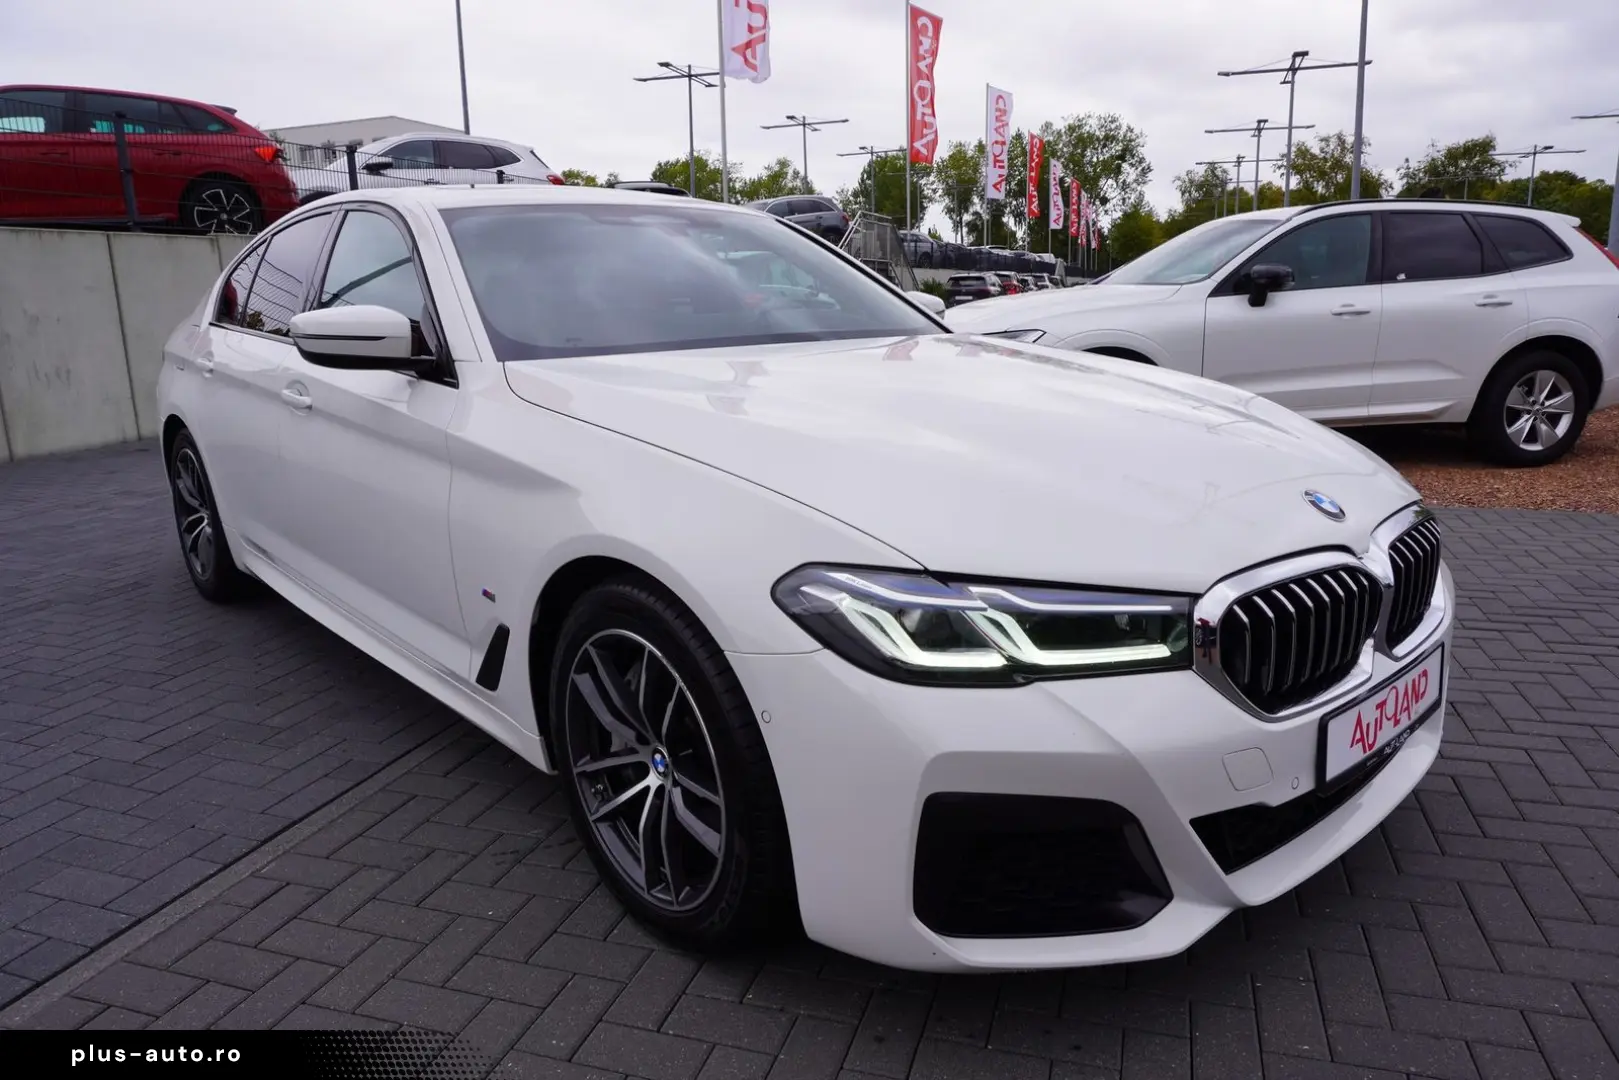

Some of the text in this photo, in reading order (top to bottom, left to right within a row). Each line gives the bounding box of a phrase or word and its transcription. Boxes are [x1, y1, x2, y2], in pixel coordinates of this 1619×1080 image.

[732, 0, 768, 73] AU
[1070, 181, 1079, 234] AUTLAND
[1349, 668, 1428, 755] AUTOLAND
